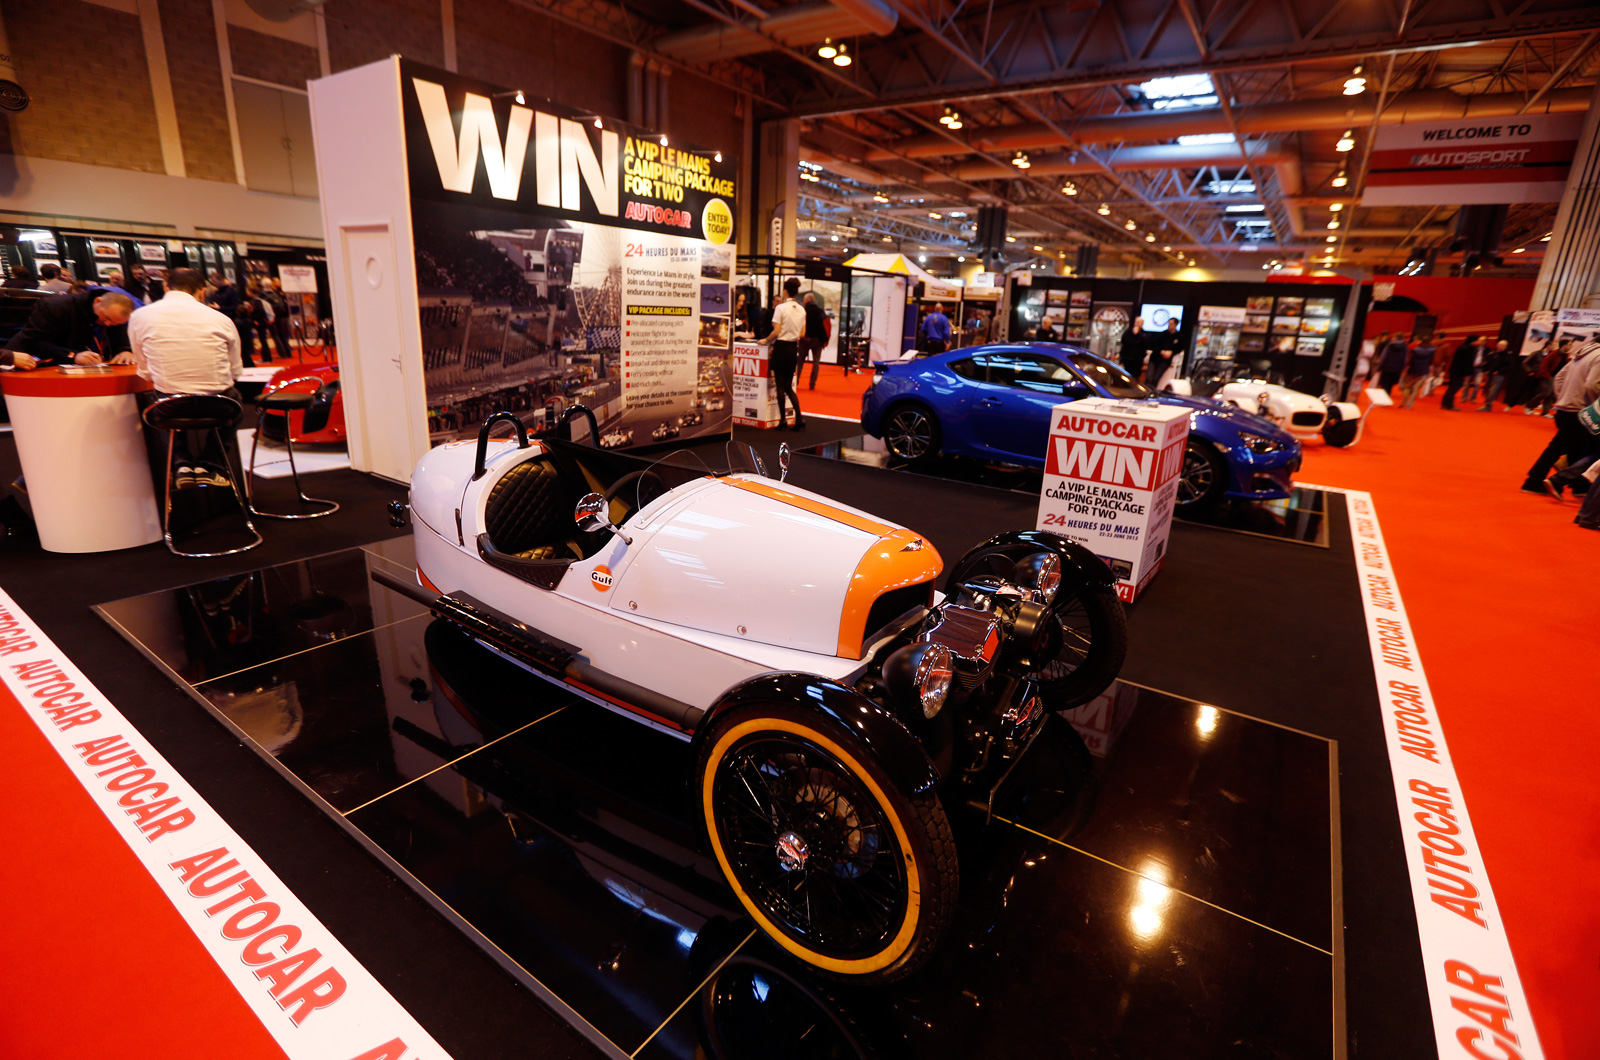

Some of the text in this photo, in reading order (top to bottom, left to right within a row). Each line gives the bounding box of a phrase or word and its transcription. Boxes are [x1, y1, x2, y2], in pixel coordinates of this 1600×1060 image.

[1422, 124, 1531, 141] WELCOME TO
[412, 77, 618, 217] WIN
[624, 136, 710, 176] A VIP LE MANS
[1417, 149, 1531, 166] AUTOSPORT
[624, 155, 734, 198] CAMPING PACKAGE
[624, 174, 684, 203] FOR TWO
[625, 201, 692, 229] AUTOCAR
[708, 212, 728, 224] ENTER
[708, 222, 730, 235] TODAY!
[625, 243, 697, 257] 24 HEURES DU MANS
[626, 267, 656, 276] Experience
[664, 270, 677, 278] Mans
[678, 271, 682, 279] in
[646, 279, 663, 288] during
[626, 288, 655, 296] endurance
[629, 306, 639, 314] VIP
[639, 306, 664, 315] PACKAGE
[625, 394, 639, 402] Leave
[640, 393, 650, 401] your
[651, 391, 665, 399] details
[678, 389, 693, 397] counter
[634, 402, 644, 410] your
[645, 400, 660, 408] chance
[1057, 415, 1157, 443] AUTOCAR
[1055, 437, 1154, 489] WIN
[1161, 440, 1184, 484] WIN
[1045, 488, 1093, 506] CAMPING
[1095, 497, 1145, 516] PACKAGE
[1058, 481, 1133, 502] A VIP LE MANS
[1043, 513, 1140, 536] 24 HEURES DU MANS
[1068, 503, 1117, 521] FOR TWO
[1361, 542, 1385, 570] AUTOCAR
[591, 571, 612, 585] Gulf
[1367, 574, 1397, 612] AUTOCAR
[1376, 617, 1414, 672] AUTOCAR
[9, 659, 103, 732] AUTOCAR
[1388, 679, 1442, 765] AUTOCAR
[73, 734, 197, 843] AUTOCAR
[1408, 778, 1489, 930] AUTOCAR
[168, 846, 347, 1028] AUTOCAR
